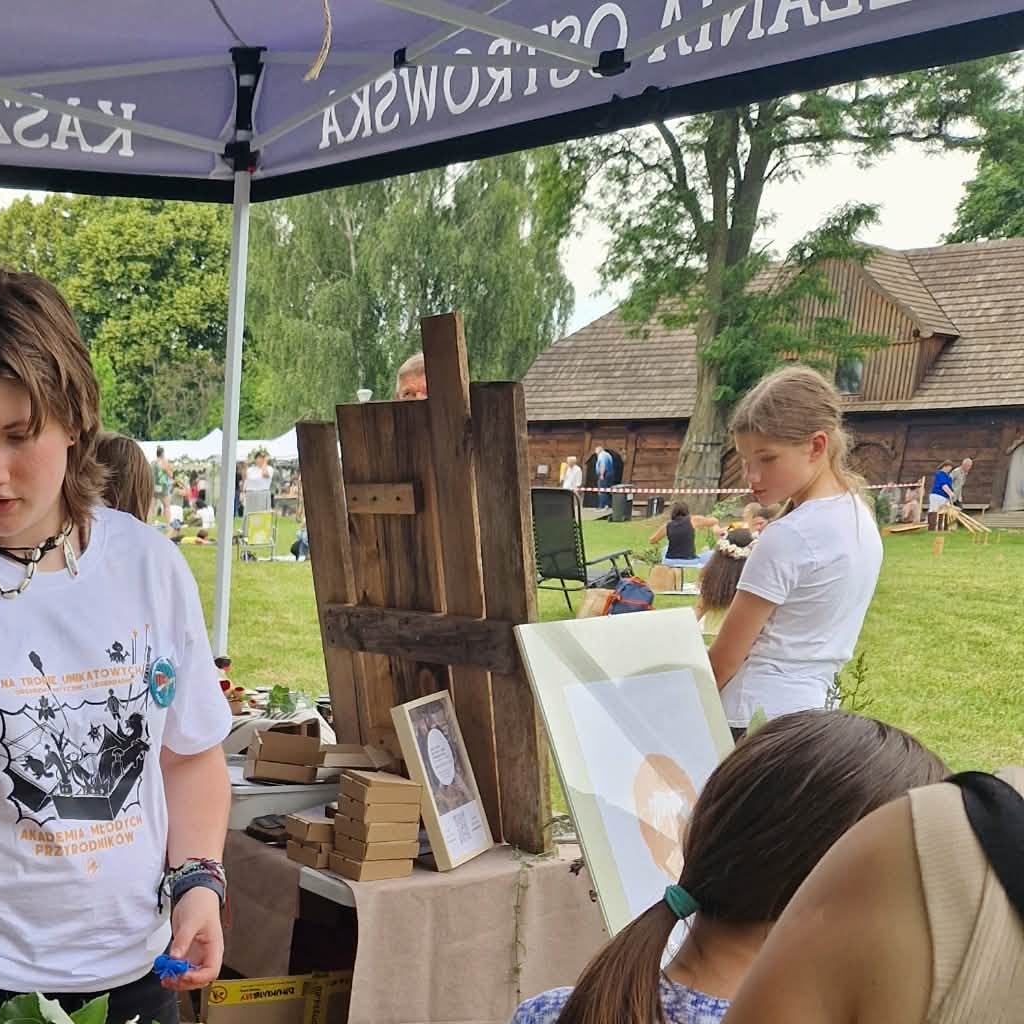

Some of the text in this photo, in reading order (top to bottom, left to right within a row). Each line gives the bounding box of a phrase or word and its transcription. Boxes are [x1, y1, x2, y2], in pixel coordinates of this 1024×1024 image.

[0, 678, 15, 688] NA
[20, 815, 143, 843] AKADEMIA MŁODYCH
